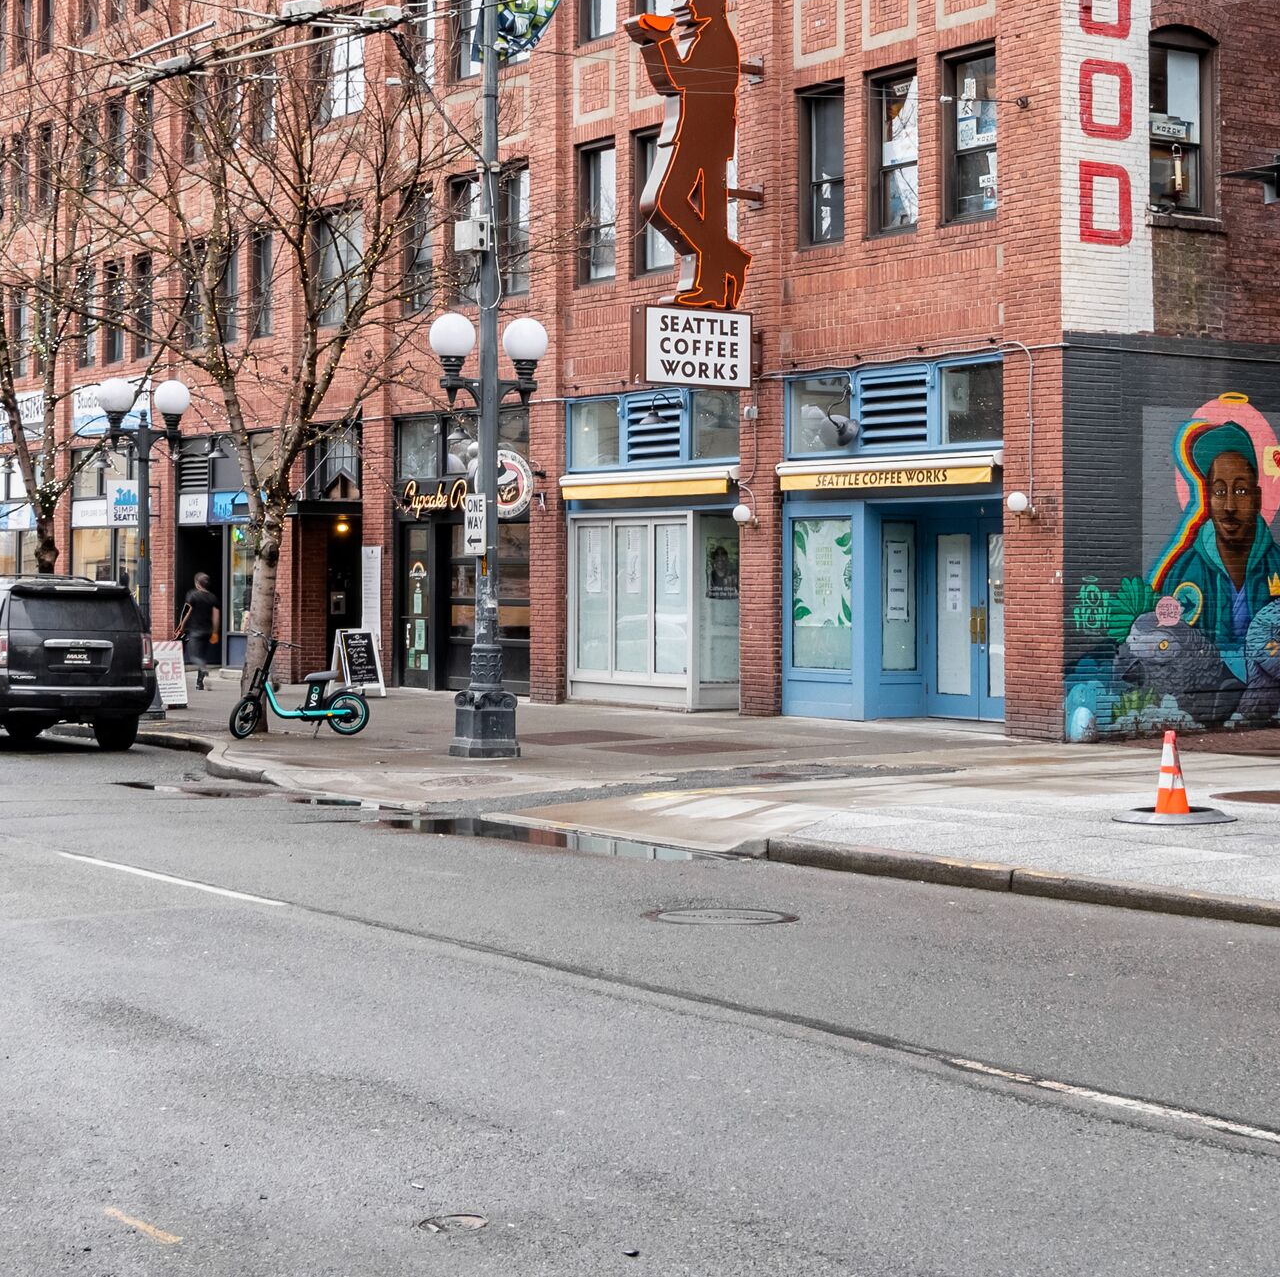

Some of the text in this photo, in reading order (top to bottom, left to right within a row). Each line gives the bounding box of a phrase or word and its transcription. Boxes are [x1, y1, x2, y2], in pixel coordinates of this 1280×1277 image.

[977, 134, 995, 142] KOZO
[981, 176, 996, 184] KOZ
[659, 315, 739, 337] SEATTLE
[659, 336, 739, 359] COFFEE
[660, 359, 739, 381] WORKS
[816, 469, 948, 487] SEATTLE COFFEE WORKS
[404, 480, 448, 519] Cupcake
[467, 499, 483, 513] ONE
[113, 506, 139, 514] SIMPL
[113, 513, 139, 522] SEATTL
[466, 515, 484, 530] WAY
[66, 653, 88, 661] MAXX
[159, 661, 182, 675] CE
[308, 686, 320, 707] veo
